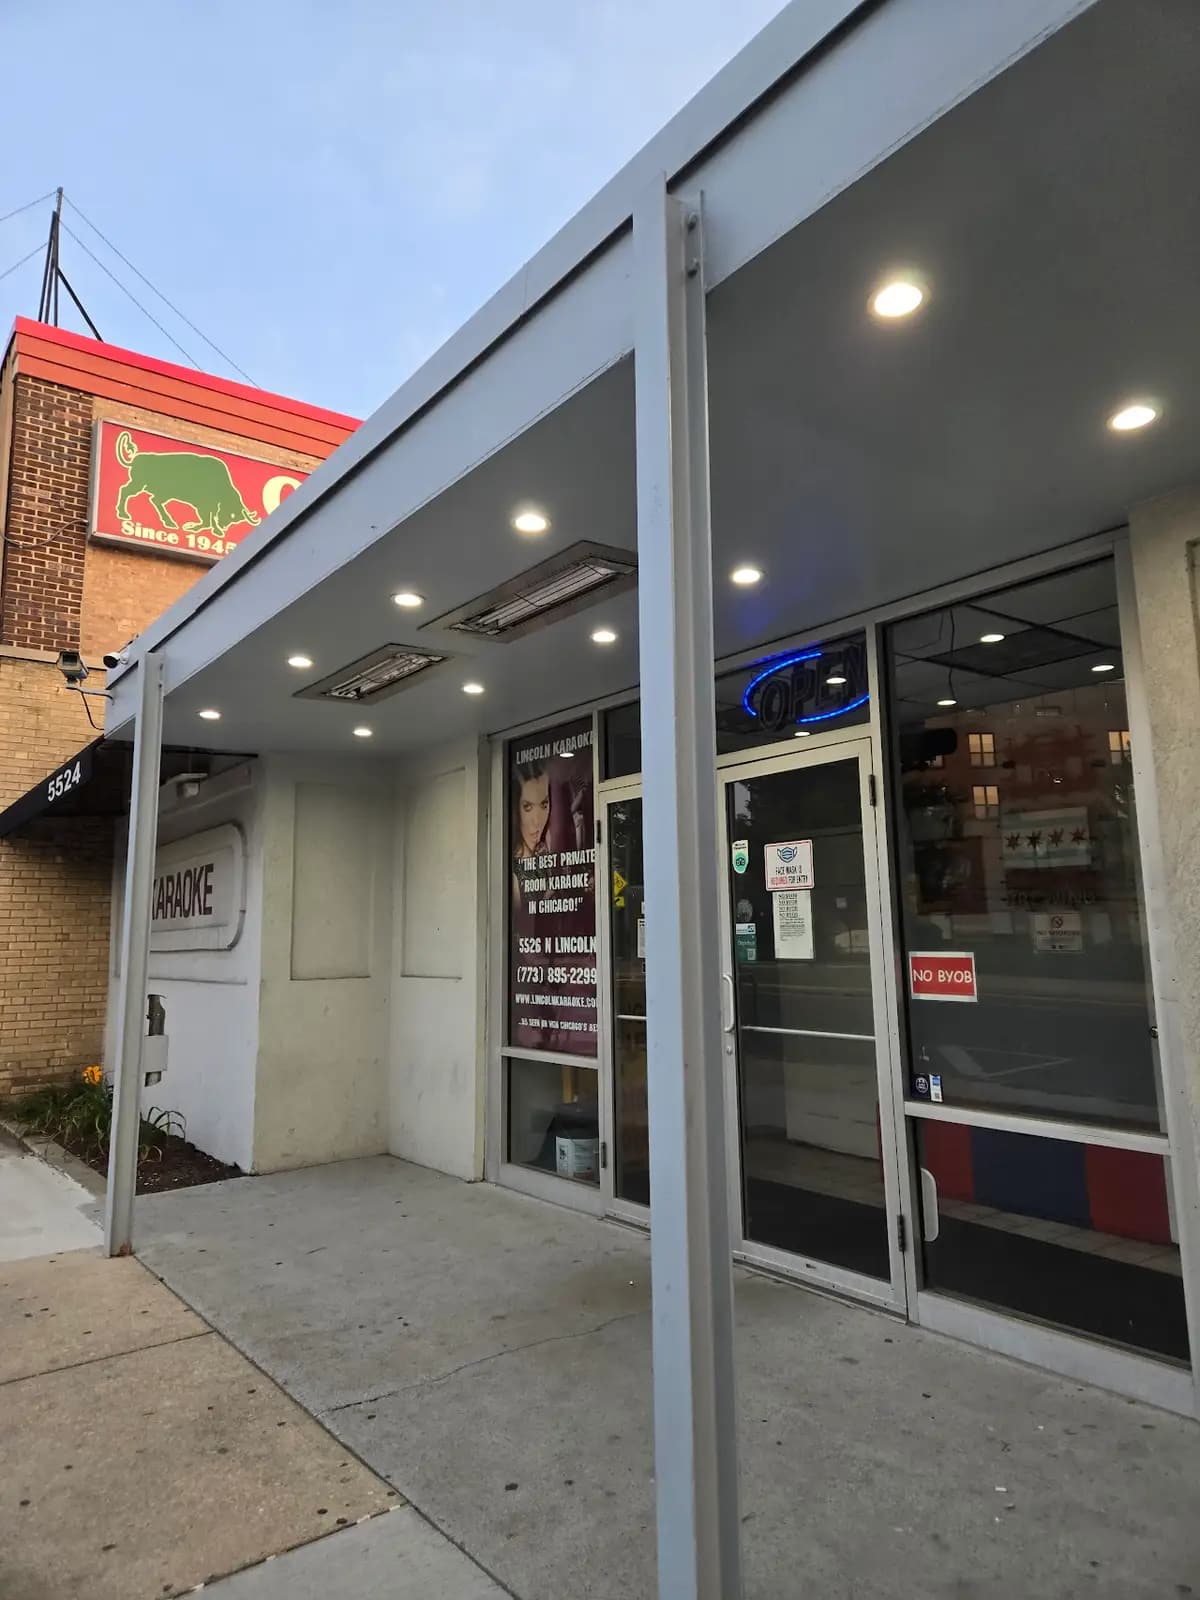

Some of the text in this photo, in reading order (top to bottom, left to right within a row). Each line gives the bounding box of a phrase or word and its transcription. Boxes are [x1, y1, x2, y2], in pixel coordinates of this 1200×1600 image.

[121, 520, 179, 543] Since
[760, 644, 866, 730] OPEN
[516, 744, 551, 764] LINCOLN
[47, 760, 81, 802] 5524
[538, 853, 558, 869] BEST
[560, 848, 596, 867] PRIVATE
[524, 873, 589, 893] ROOM KARAOKE
[528, 897, 583, 915] IN CHICAGO!"
[519, 936, 597, 954] 5526 N LINCOLN
[517, 966, 597, 985] (773) 895-2299
[913, 969, 973, 983] NO BYOB
